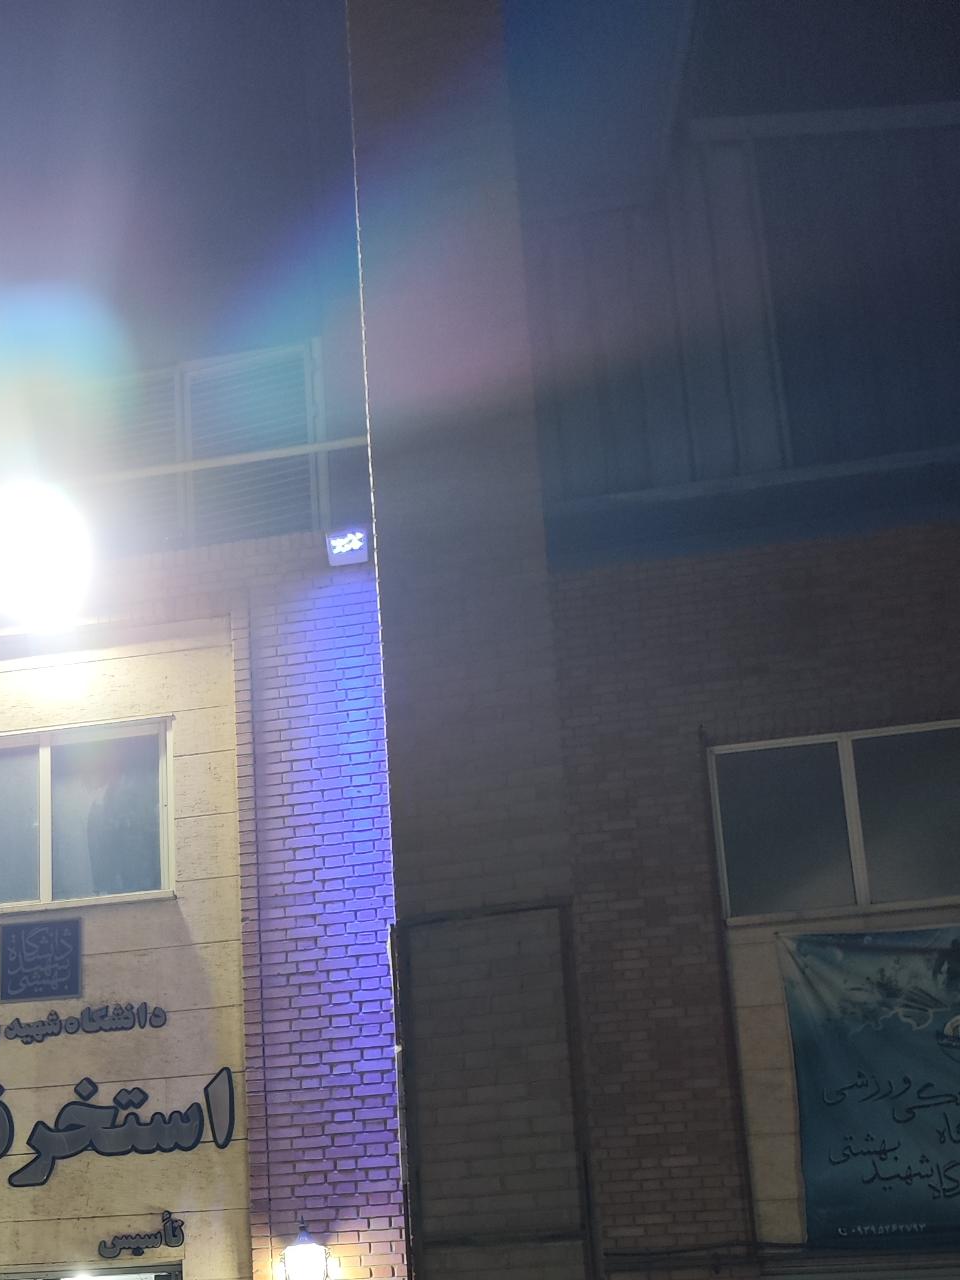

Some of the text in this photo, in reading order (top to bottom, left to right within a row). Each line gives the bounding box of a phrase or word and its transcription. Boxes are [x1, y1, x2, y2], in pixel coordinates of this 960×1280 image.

[4, 1010, 62, 1046] شهید
[64, 1002, 167, 1034] دانشگاه
[8, 1066, 235, 1188] استخر
[828, 1133, 901, 1166] بهشتی
[862, 1153, 934, 1192] شهید
